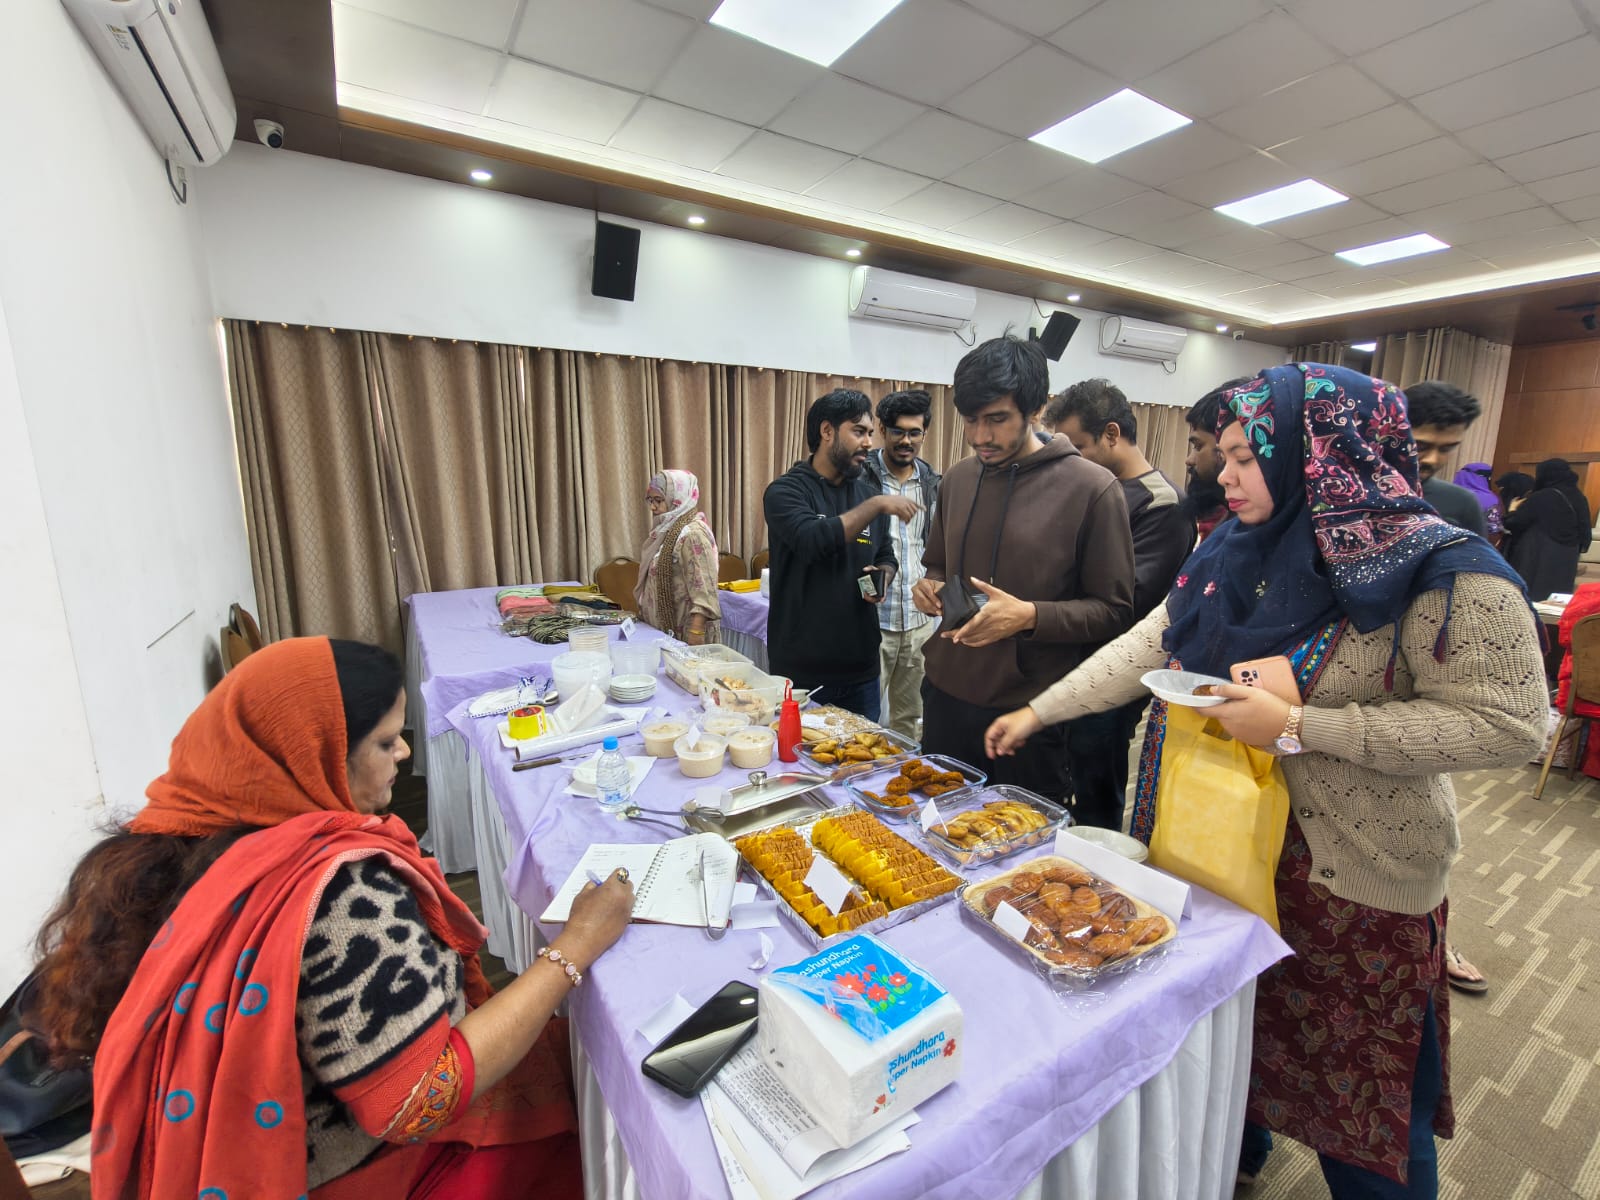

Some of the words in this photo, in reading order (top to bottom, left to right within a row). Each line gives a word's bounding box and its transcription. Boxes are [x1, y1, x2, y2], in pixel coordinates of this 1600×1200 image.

[799, 943, 861, 977] ashundhara
[831, 951, 864, 970] Napkin
[888, 1031, 945, 1072] shundhara
[911, 1047, 941, 1069] Napkin
